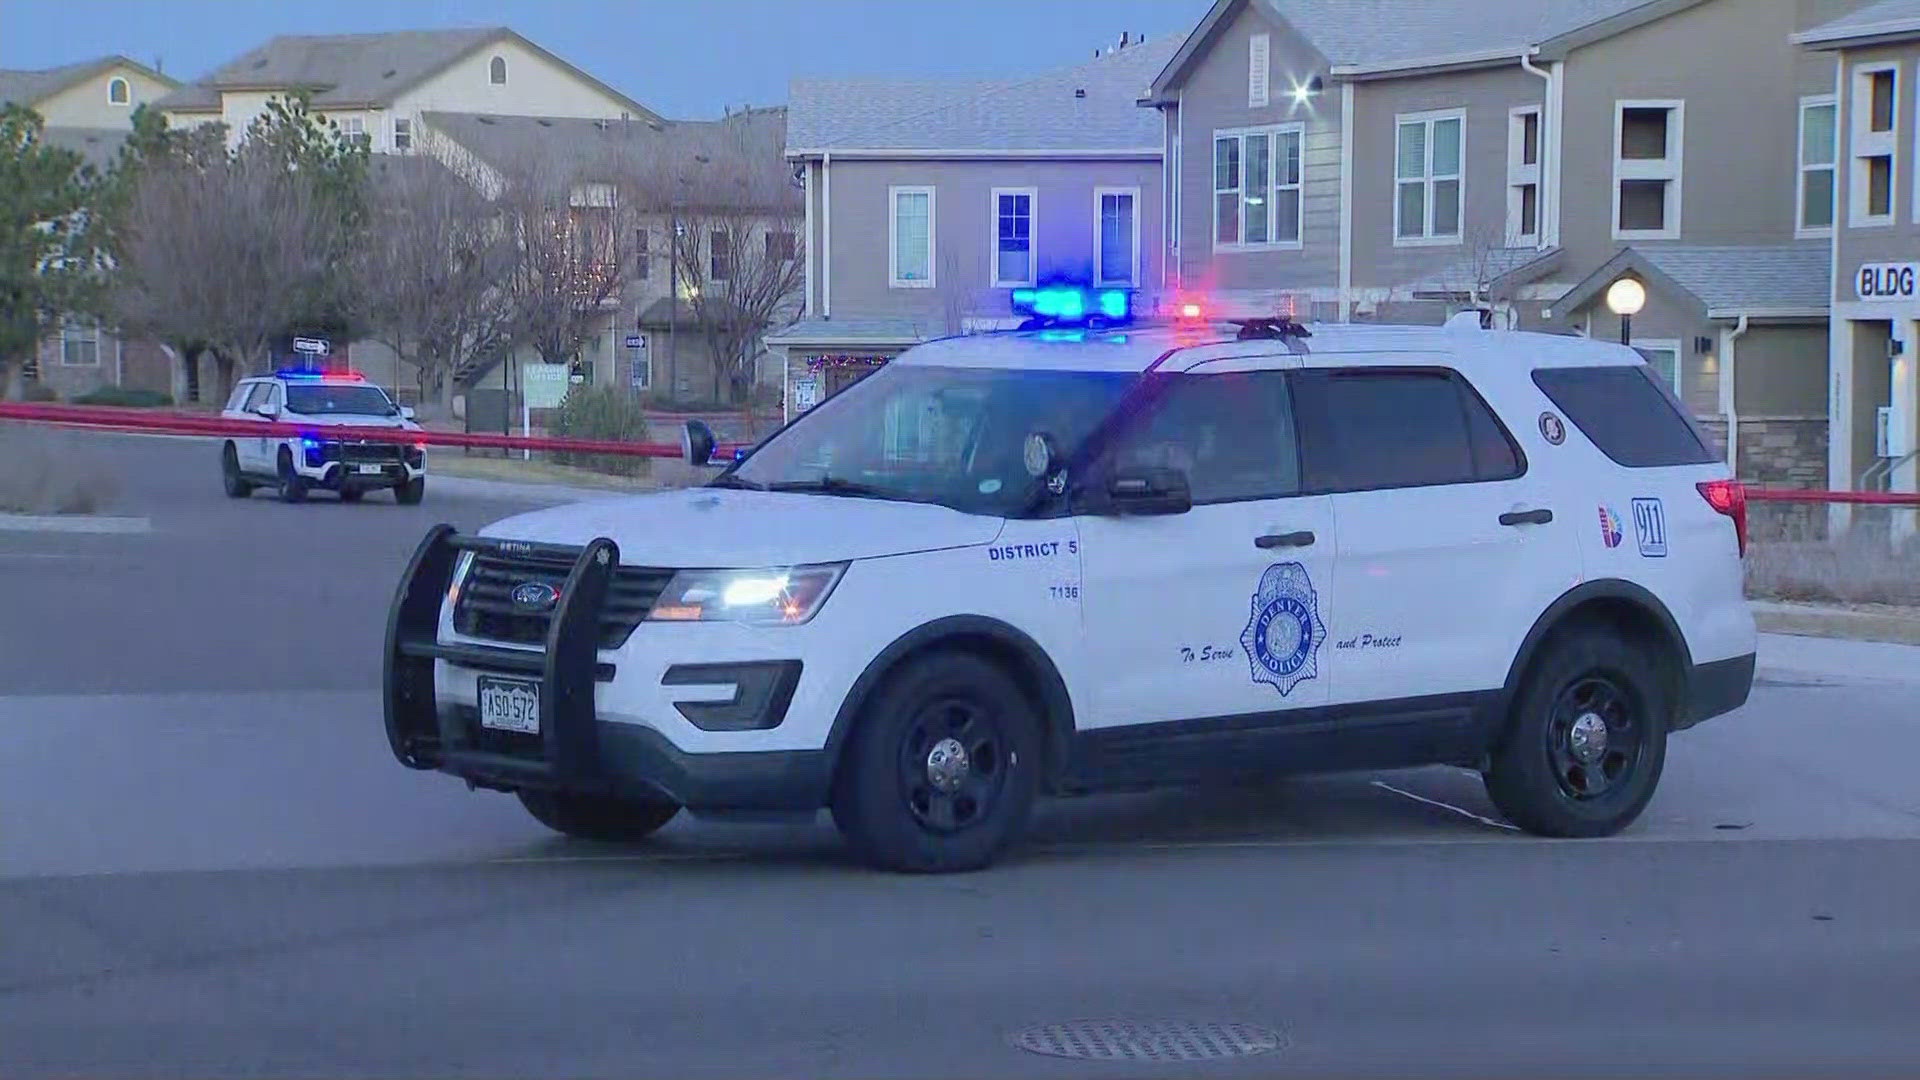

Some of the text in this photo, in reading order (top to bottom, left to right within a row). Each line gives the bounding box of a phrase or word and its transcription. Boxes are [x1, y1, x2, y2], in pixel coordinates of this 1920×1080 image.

[1861, 267, 1913, 296] BLDG
[1635, 502, 1663, 545] 911
[988, 540, 1078, 561] DISTRICT 5
[1049, 586, 1079, 599] 7136
[1260, 600, 1308, 627] DENVER
[1180, 632, 1402, 663] To Serve and Protect
[1261, 650, 1306, 673] POLICE
